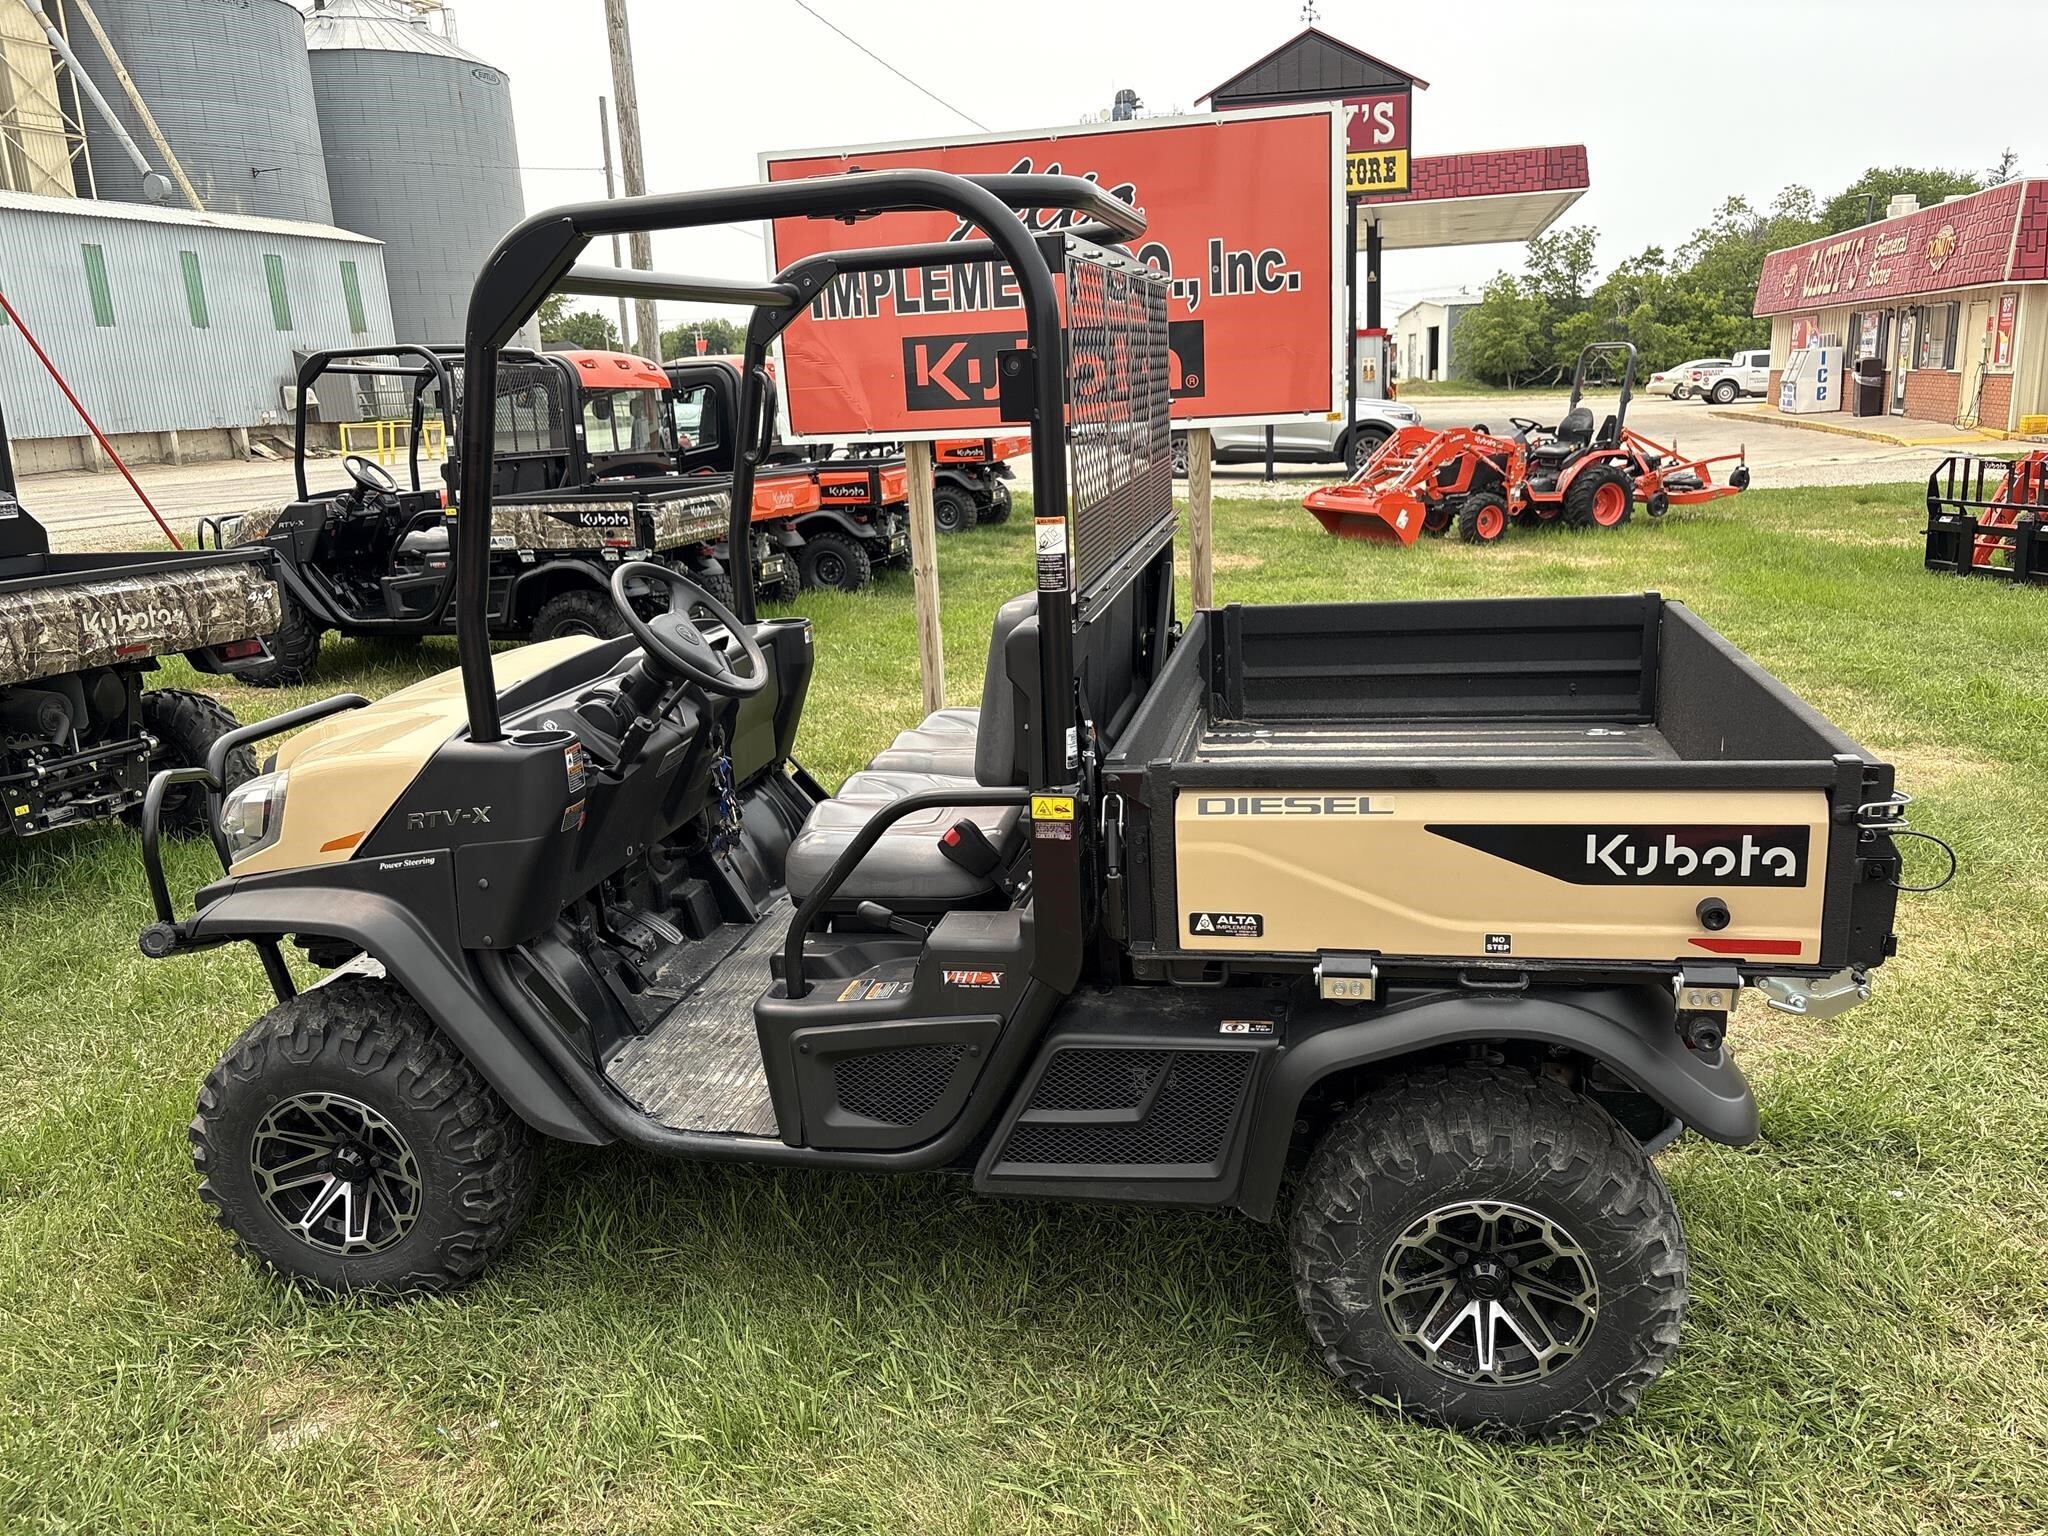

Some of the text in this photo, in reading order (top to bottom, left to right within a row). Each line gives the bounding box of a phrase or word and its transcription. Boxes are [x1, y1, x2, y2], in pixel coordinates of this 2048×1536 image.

[1925, 234, 1957, 259] DONUTS
[1802, 227, 1911, 298] CASEY'S General
[811, 262, 1080, 321] MPLEME
[1208, 237, 1301, 297] Inc.
[1866, 260, 1891, 288] Store
[956, 448, 984, 457] Kubota
[829, 486, 865, 497] Kubota
[278, 519, 304, 529] RTV-X
[580, 513, 629, 526] Kubota
[248, 588, 273, 602] 4x4
[83, 603, 173, 637] Kubota
[1198, 797, 1394, 816] DIESEL
[407, 806, 491, 830] RTV-X
[380, 857, 435, 870] Power Steering
[1586, 834, 1797, 877] Kubota
[1217, 915, 1257, 925] ALTA
[943, 970, 1004, 985] VHT-X
